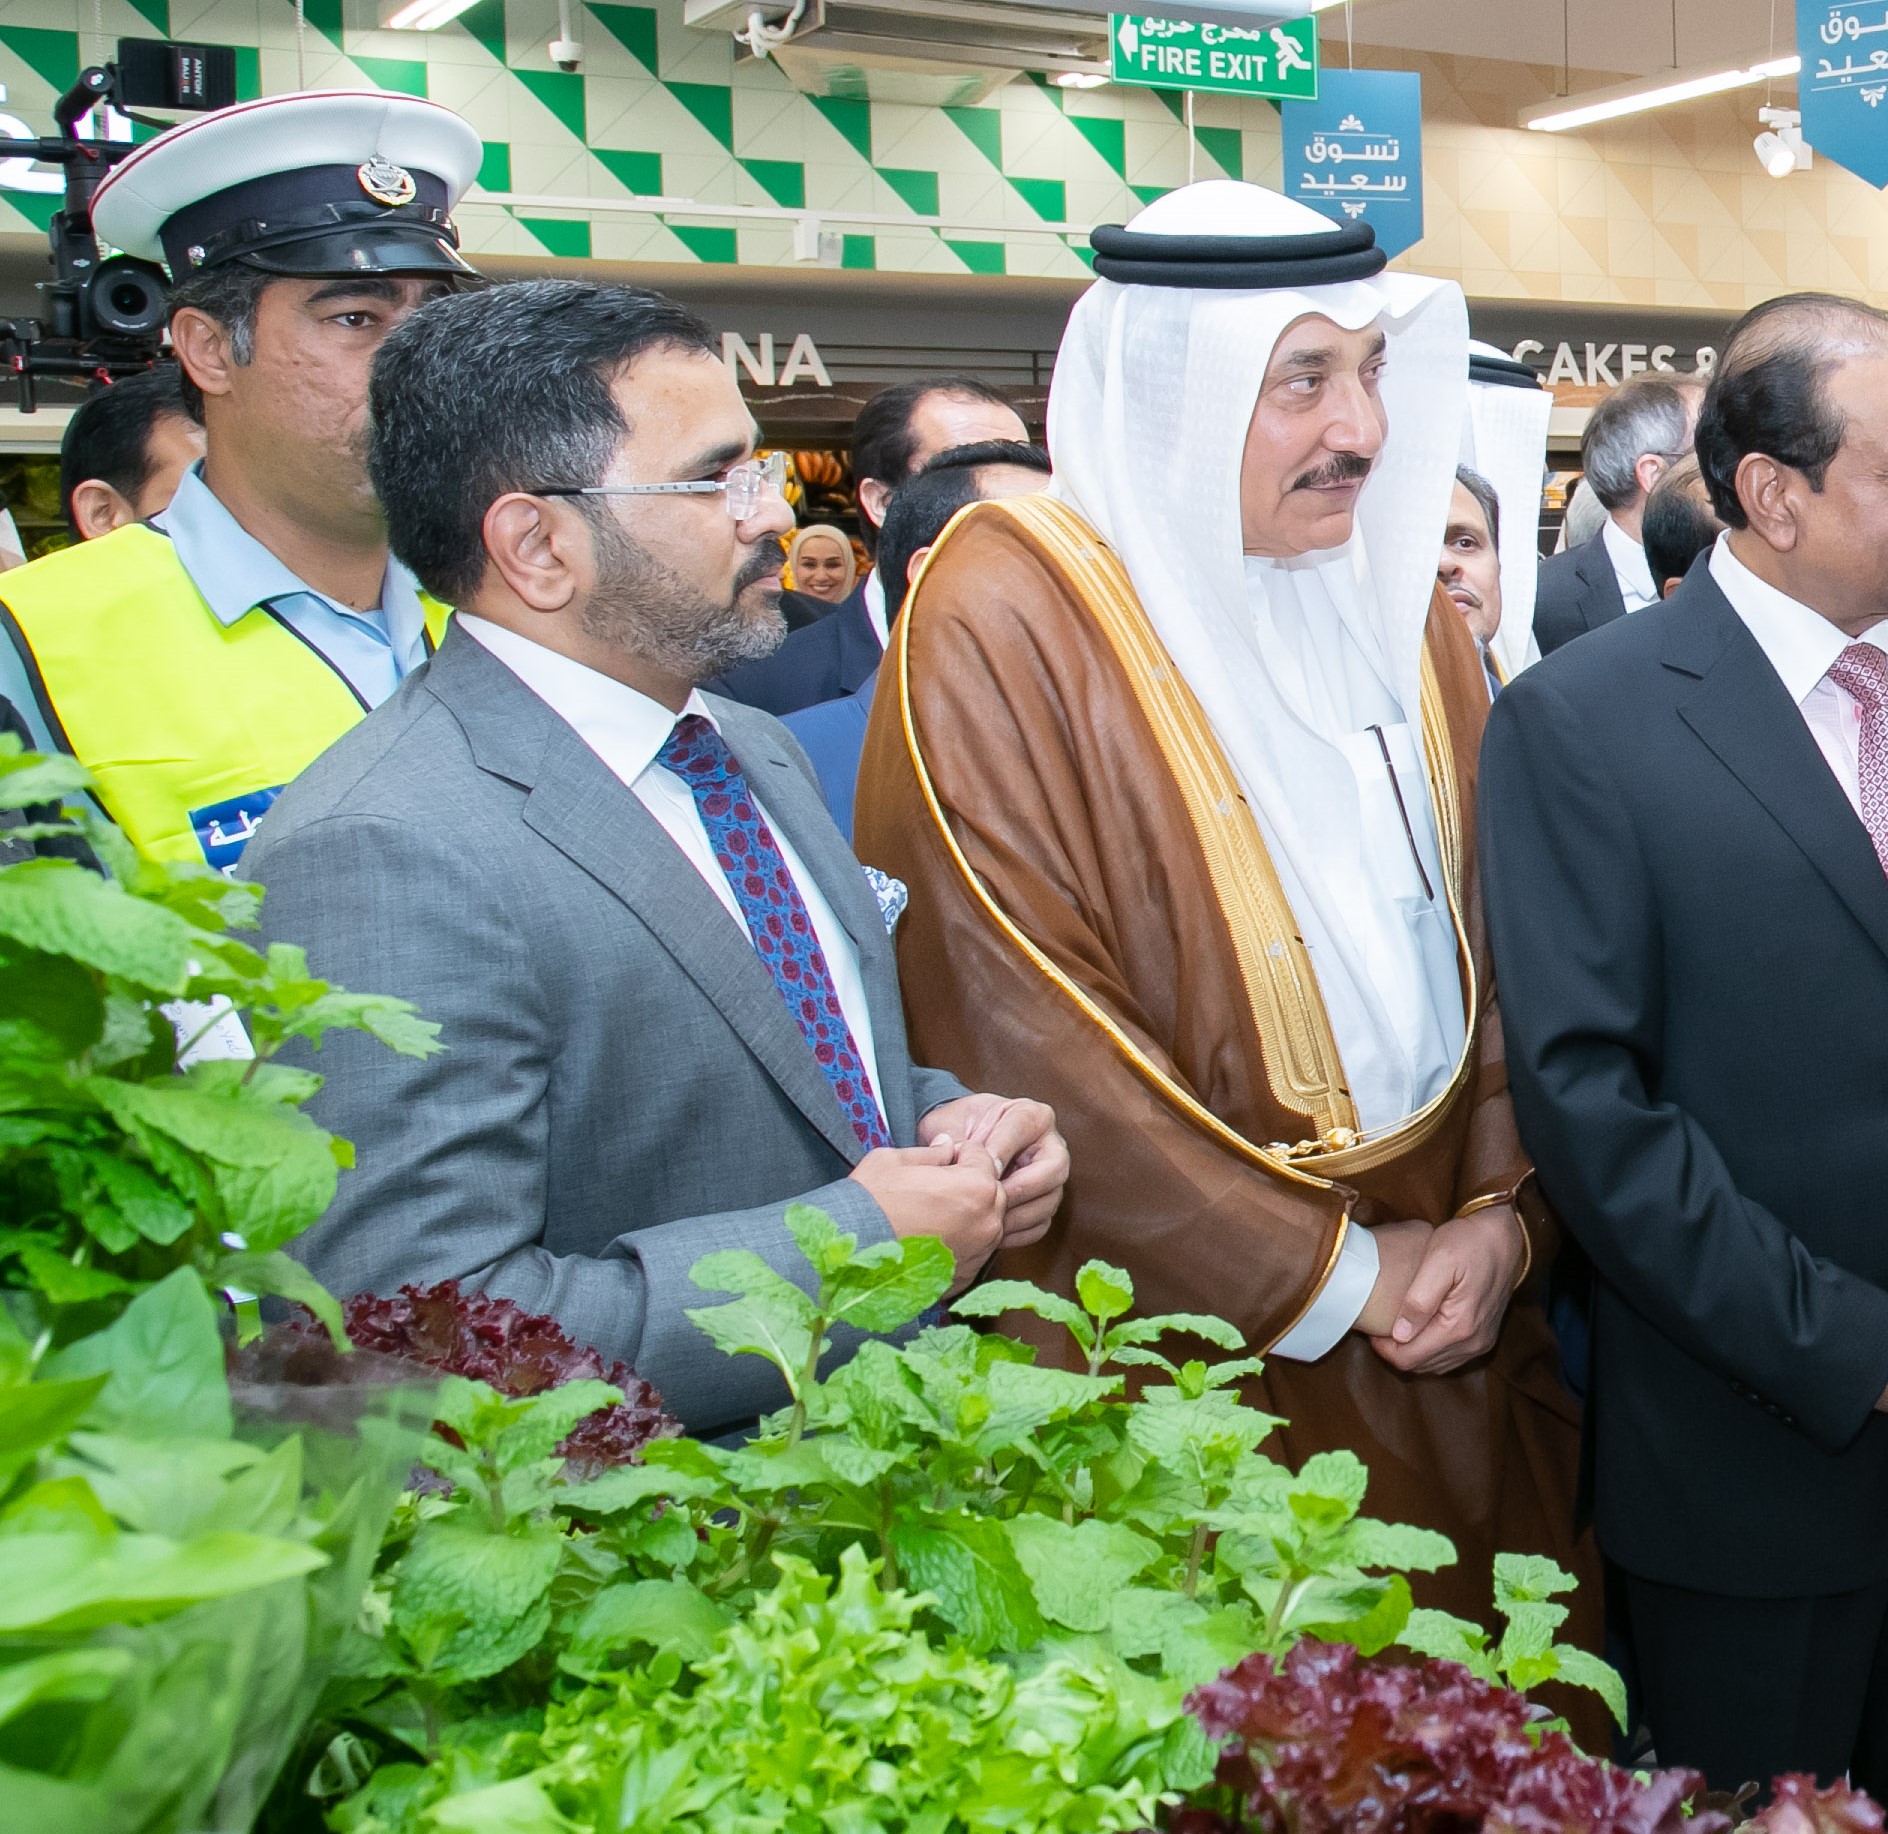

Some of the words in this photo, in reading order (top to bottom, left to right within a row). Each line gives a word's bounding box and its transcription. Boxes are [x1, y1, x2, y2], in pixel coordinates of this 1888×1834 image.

[1141, 44, 1202, 76] FIRE
[1209, 51, 1268, 82] EXIT
[1305, 136, 1400, 164] تسوق
[1300, 172, 1407, 196] سعيد
[721, 331, 833, 387] NA
[1512, 339, 1677, 387] CAKES
